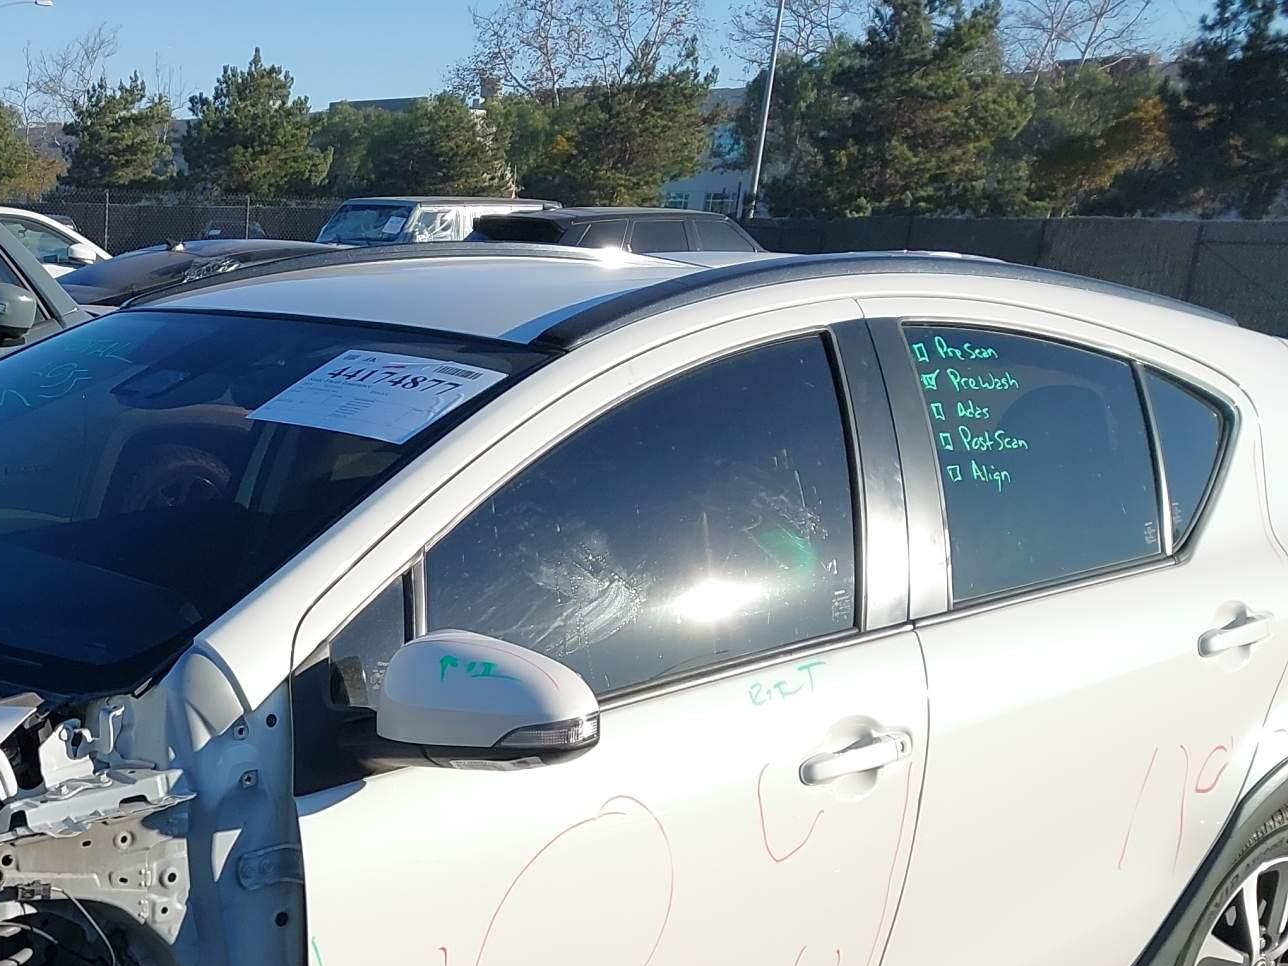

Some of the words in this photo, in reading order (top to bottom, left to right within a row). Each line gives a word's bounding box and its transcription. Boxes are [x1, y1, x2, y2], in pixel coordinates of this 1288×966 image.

[327, 366, 463, 395] 44174877
[957, 400, 990, 419] Adas
[971, 460, 1011, 493] Align
